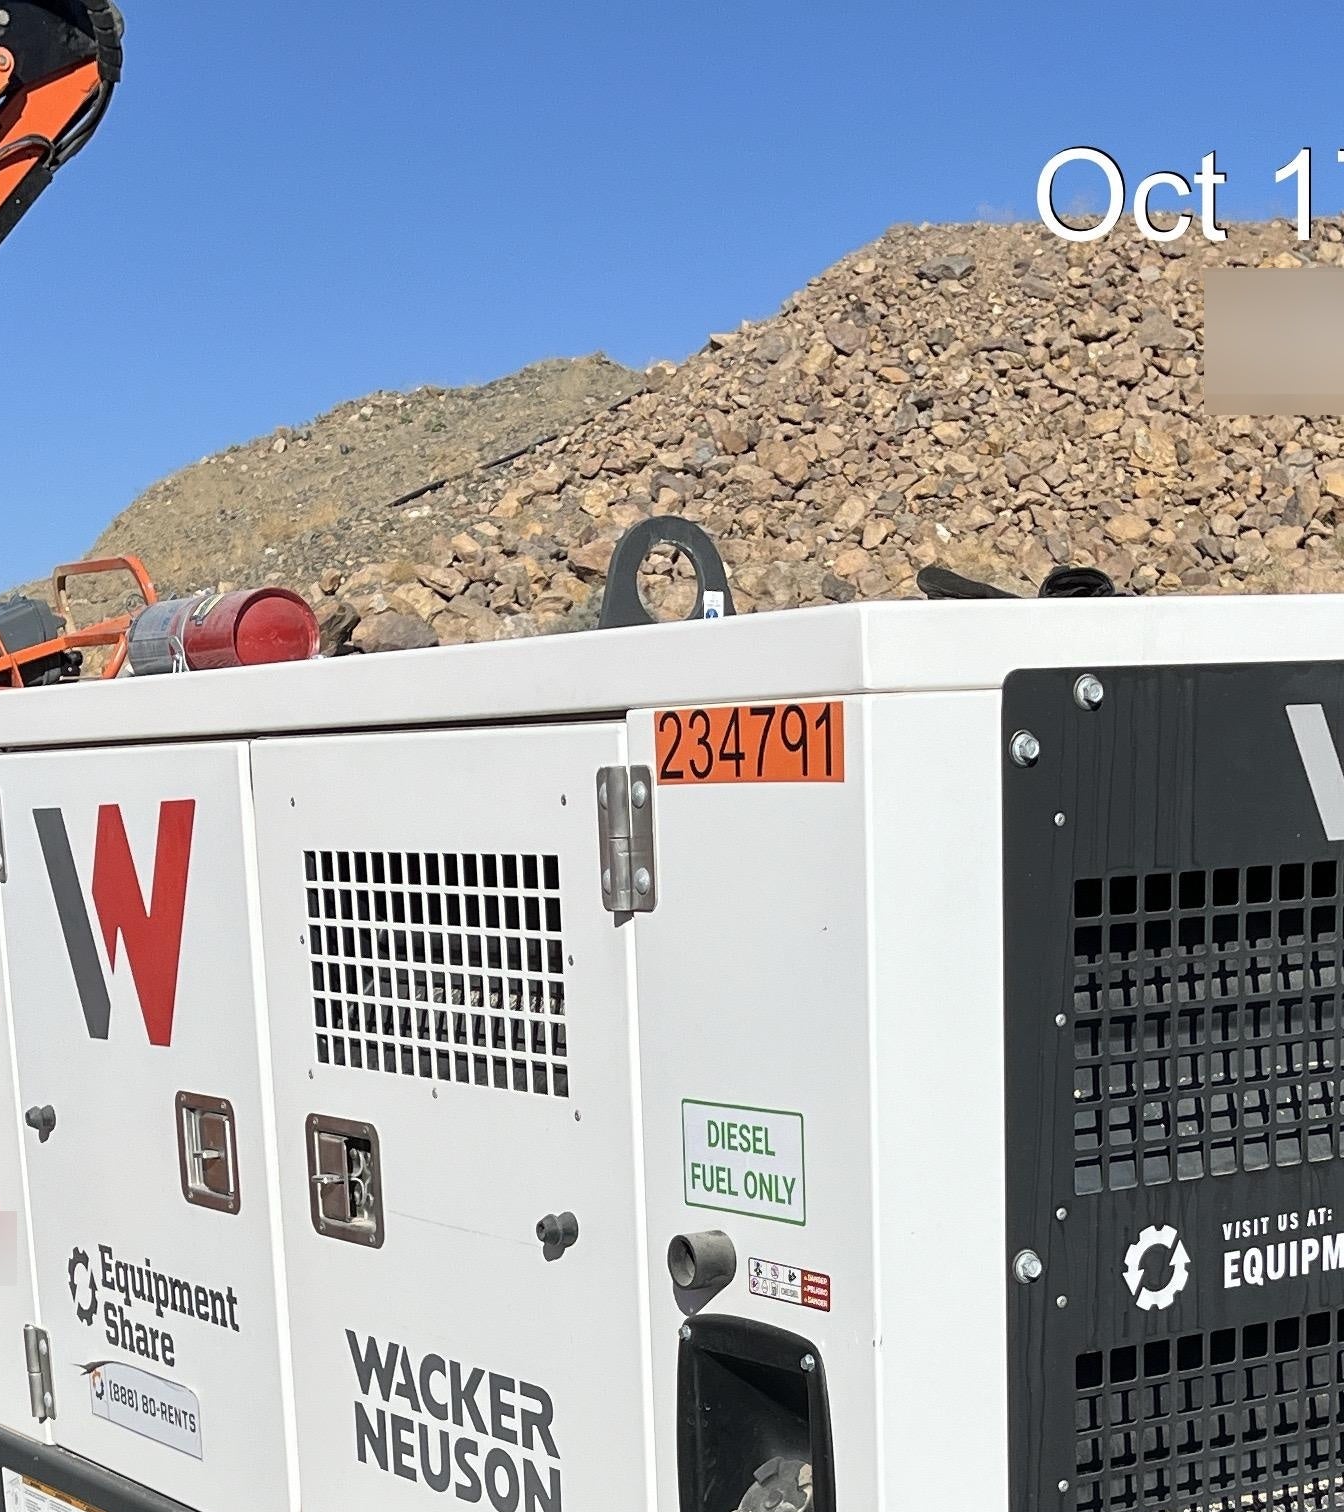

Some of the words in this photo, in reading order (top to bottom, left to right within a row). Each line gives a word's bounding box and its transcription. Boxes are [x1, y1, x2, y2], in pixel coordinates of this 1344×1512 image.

[658, 702, 834, 780] 234791
[707, 1119, 776, 1157] DIESEL
[690, 1162, 739, 1197] FUEL
[744, 1170, 796, 1206] ONLY
[1222, 1217, 1270, 1242] VISIT
[1277, 1211, 1300, 1232] US
[1306, 1206, 1334, 1228] AT:
[98, 1243, 240, 1332] Equipment
[104, 1300, 175, 1367] Share
[108, 1379, 139, 1413] (888)
[142, 1394, 197, 1434] 80-RENTS
[344, 1328, 561, 1460] WACKER
